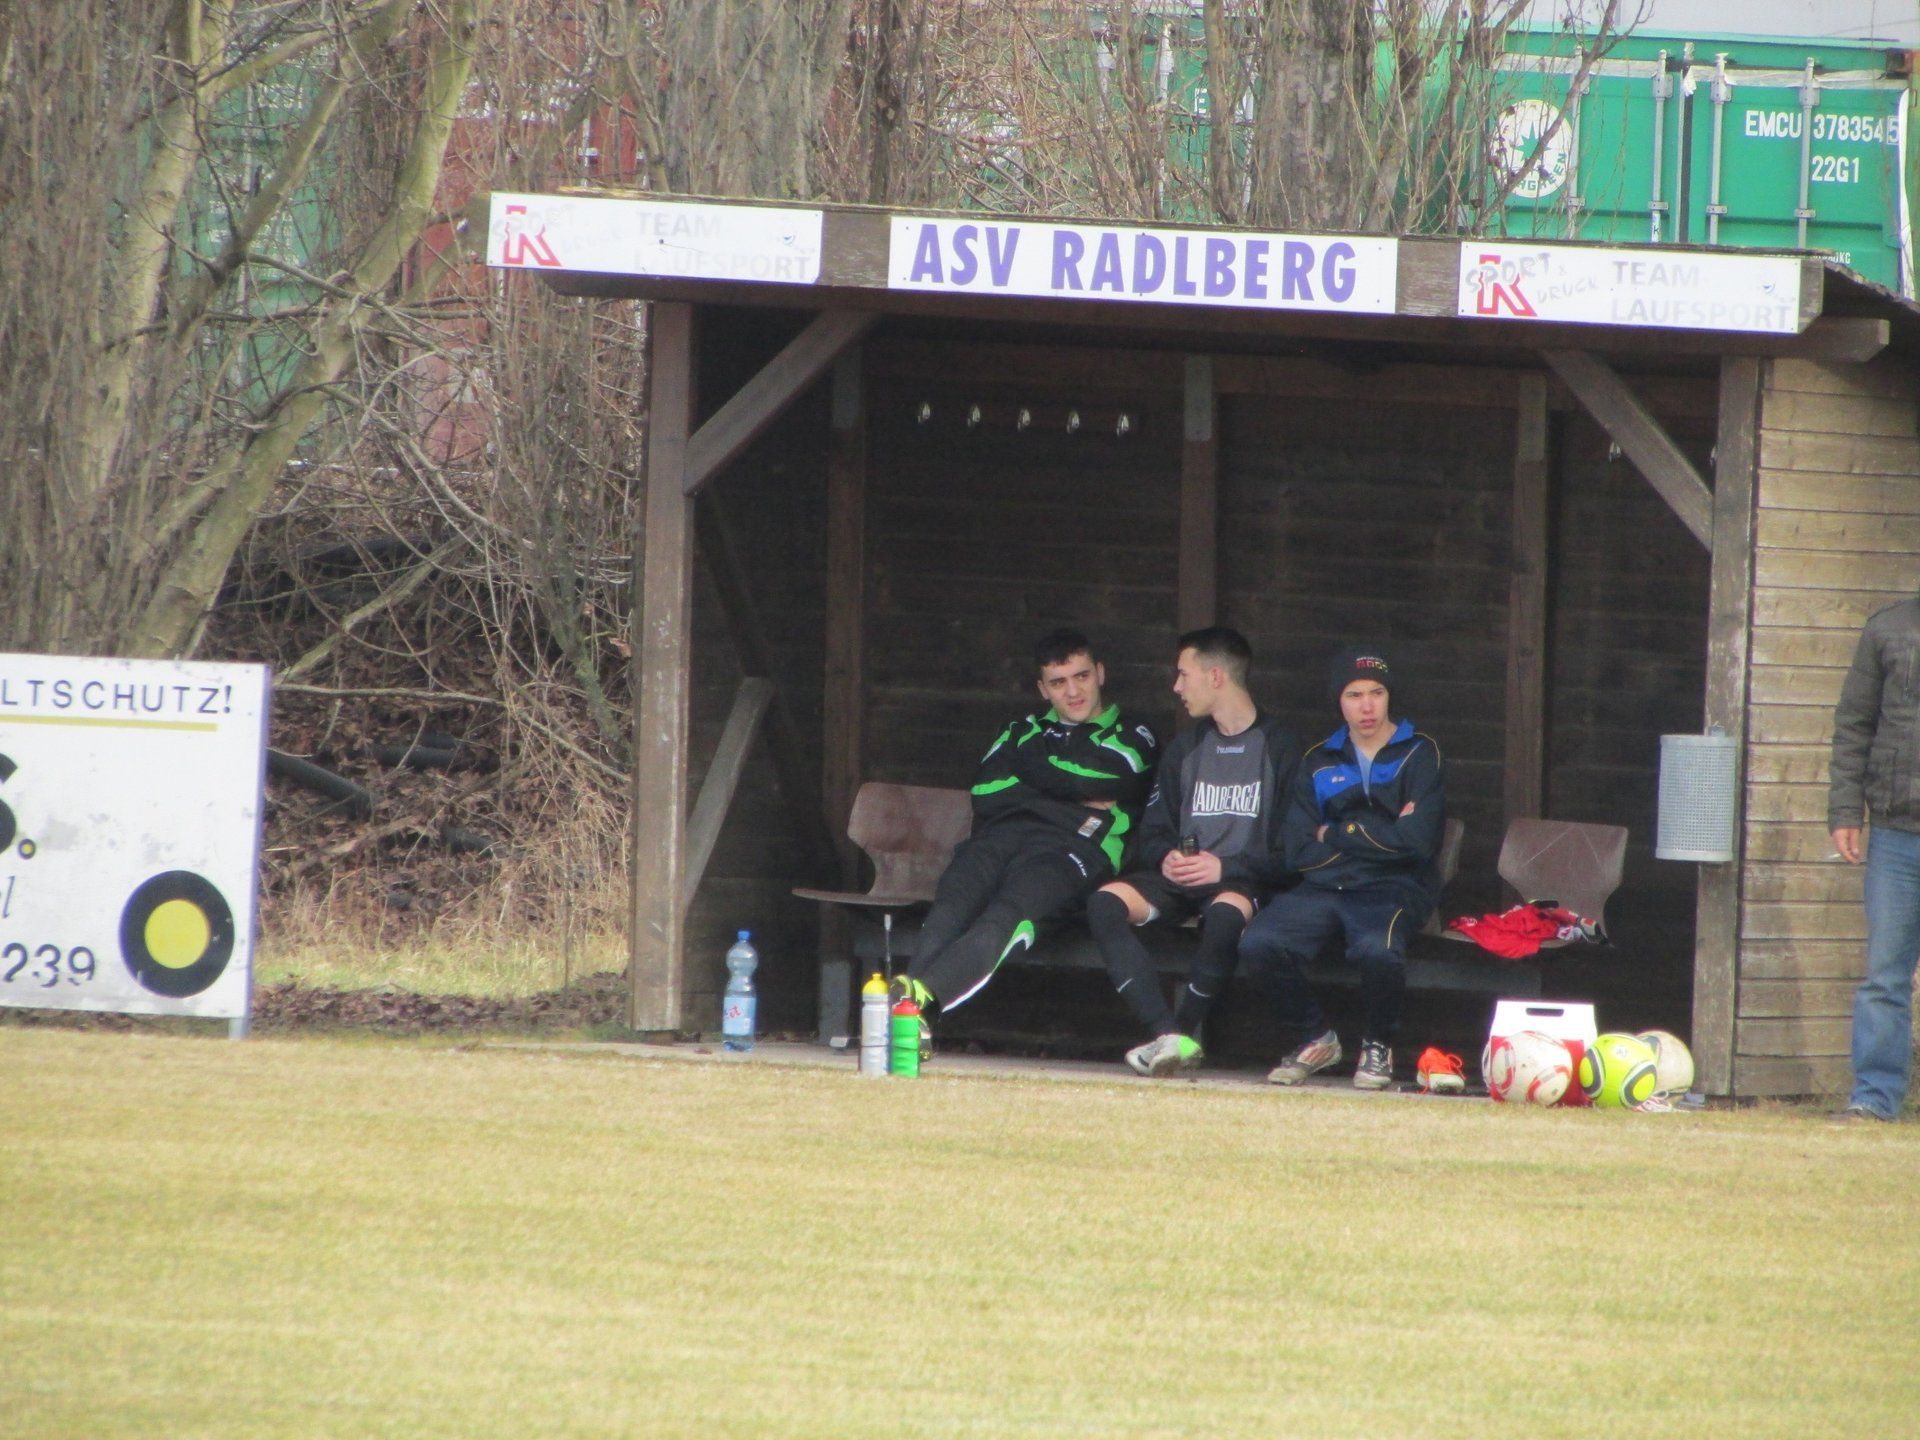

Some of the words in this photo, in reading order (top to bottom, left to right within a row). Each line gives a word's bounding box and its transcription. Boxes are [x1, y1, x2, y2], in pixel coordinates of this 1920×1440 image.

[1745, 110, 1802, 138] EMCU
[1813, 113, 1884, 143] 378354
[1811, 155, 1860, 183] 22G1
[636, 211, 722, 239] TEAM
[911, 223, 1020, 286] ASV
[1051, 230, 1356, 303] RADLBERG
[1465, 252, 1551, 293] SPORT
[1612, 260, 1701, 289] TEAM
[1610, 299, 1792, 331] LAUFSPORT
[2, 679, 232, 713] LTSCHUTZ!
[2, 942, 96, 988] 239
